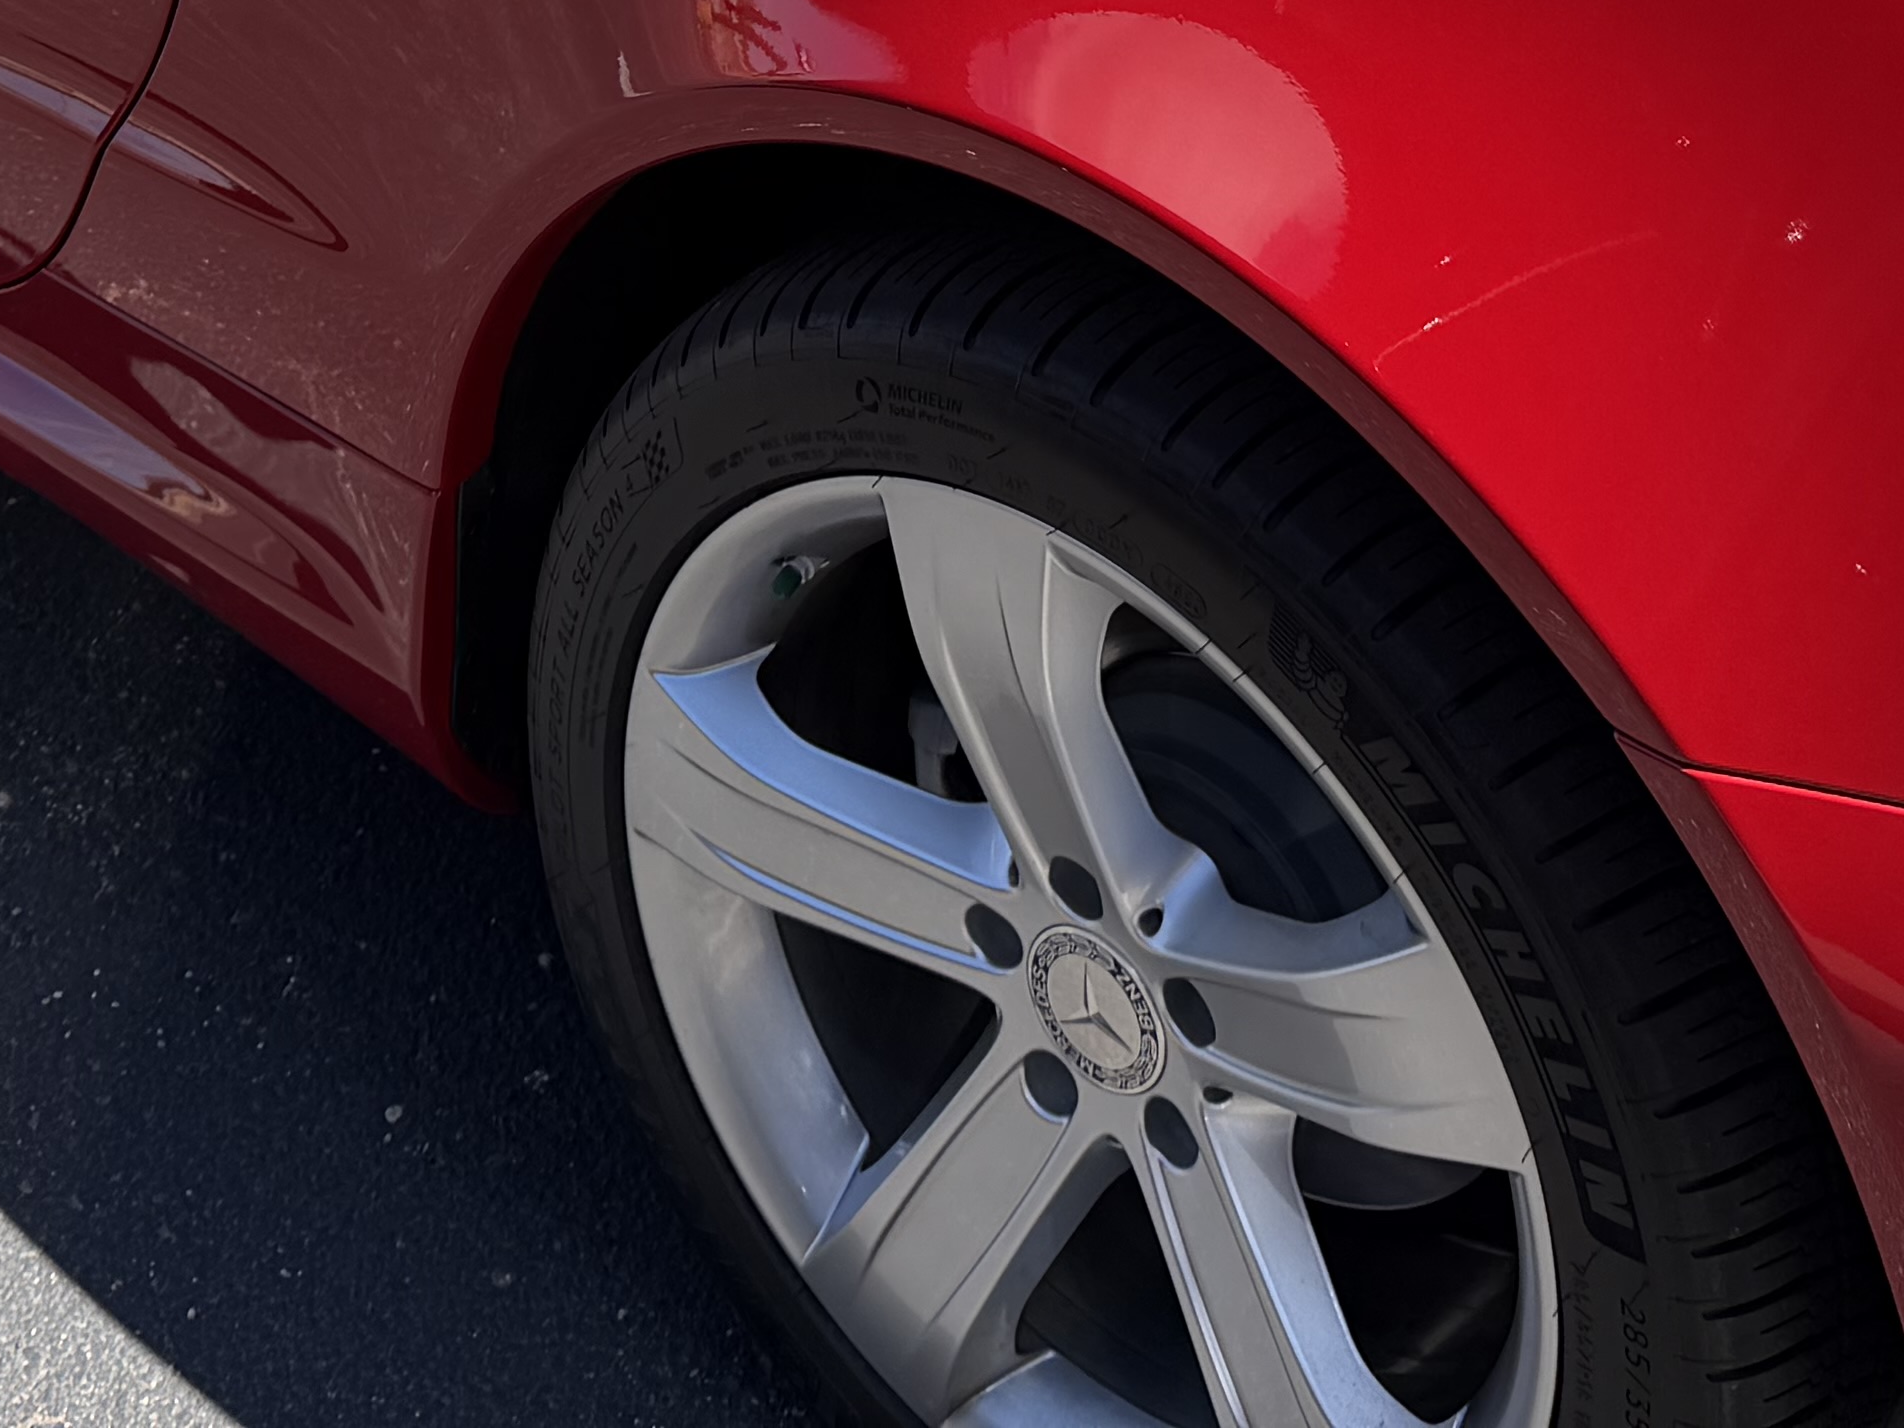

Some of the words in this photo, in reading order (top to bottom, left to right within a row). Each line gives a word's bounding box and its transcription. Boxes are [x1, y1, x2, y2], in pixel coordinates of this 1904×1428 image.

[888, 382, 963, 414] MICHELIN
[556, 599, 580, 659] ALL
[571, 488, 625, 598] SEASON
[1115, 969, 1154, 1031] BENZ
[1362, 736, 1632, 1238] MICHELIN
